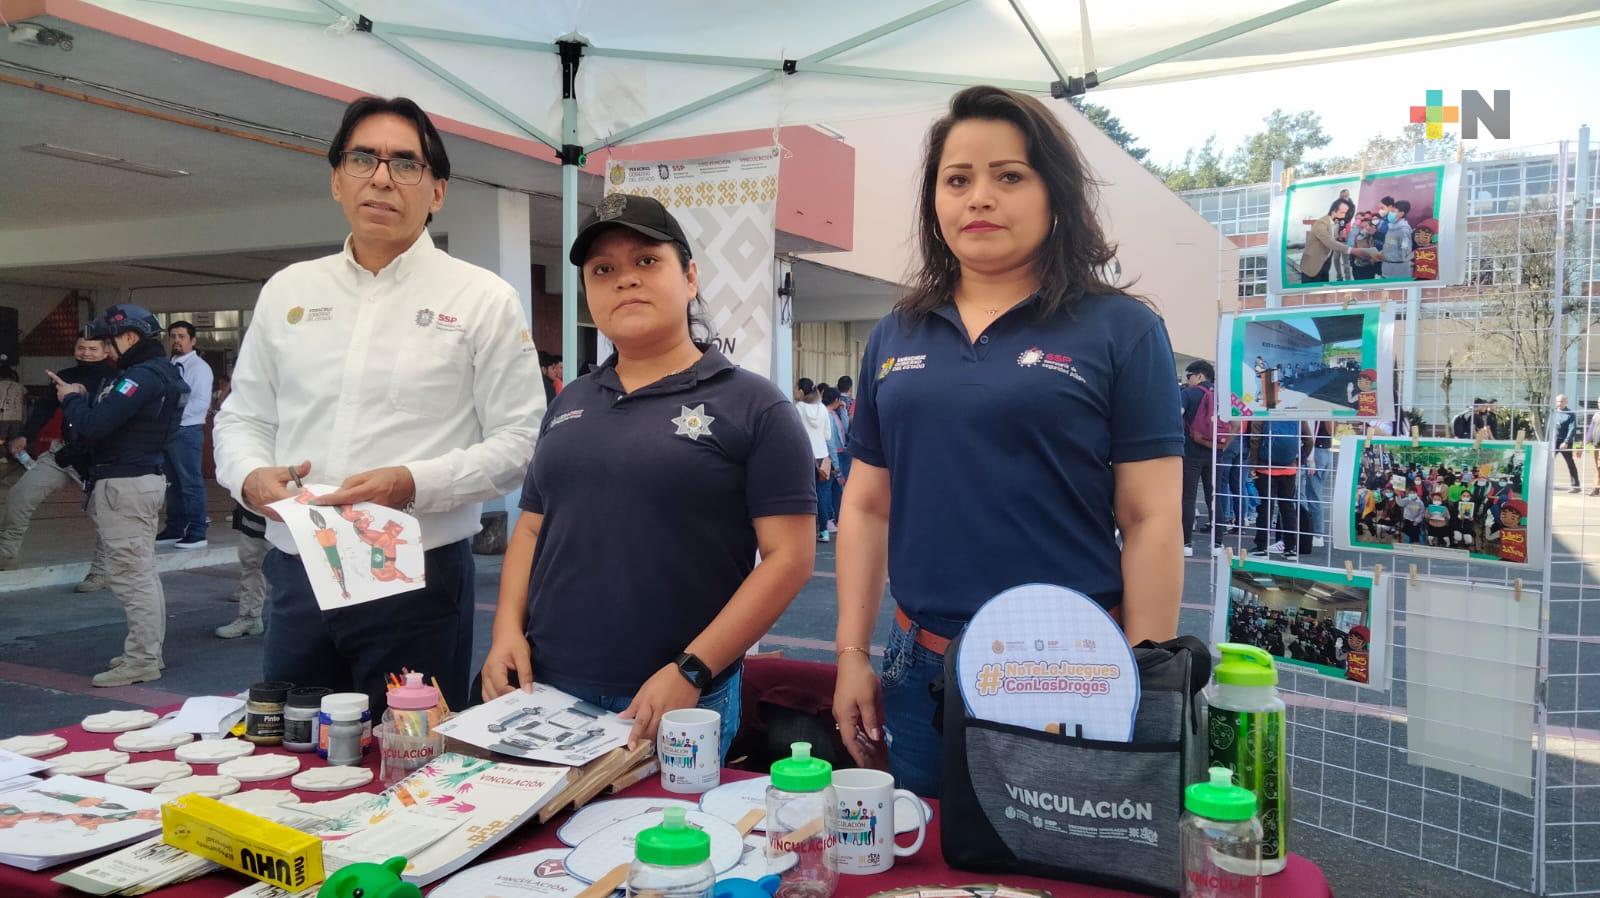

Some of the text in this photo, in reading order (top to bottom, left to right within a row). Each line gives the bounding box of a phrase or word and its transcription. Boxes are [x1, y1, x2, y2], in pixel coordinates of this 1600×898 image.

[438, 313, 458, 324] SSP
[1045, 352, 1073, 364] SSP
[1005, 679, 1110, 697] ConLasDrogas
[480, 774, 545, 788] VINCULACIÓN
[1005, 783, 1153, 821] VINCULACIÓN
[768, 832, 838, 854] VINCULACIÓN
[240, 847, 292, 887] UHU
[294, 855, 305, 887] UHU
